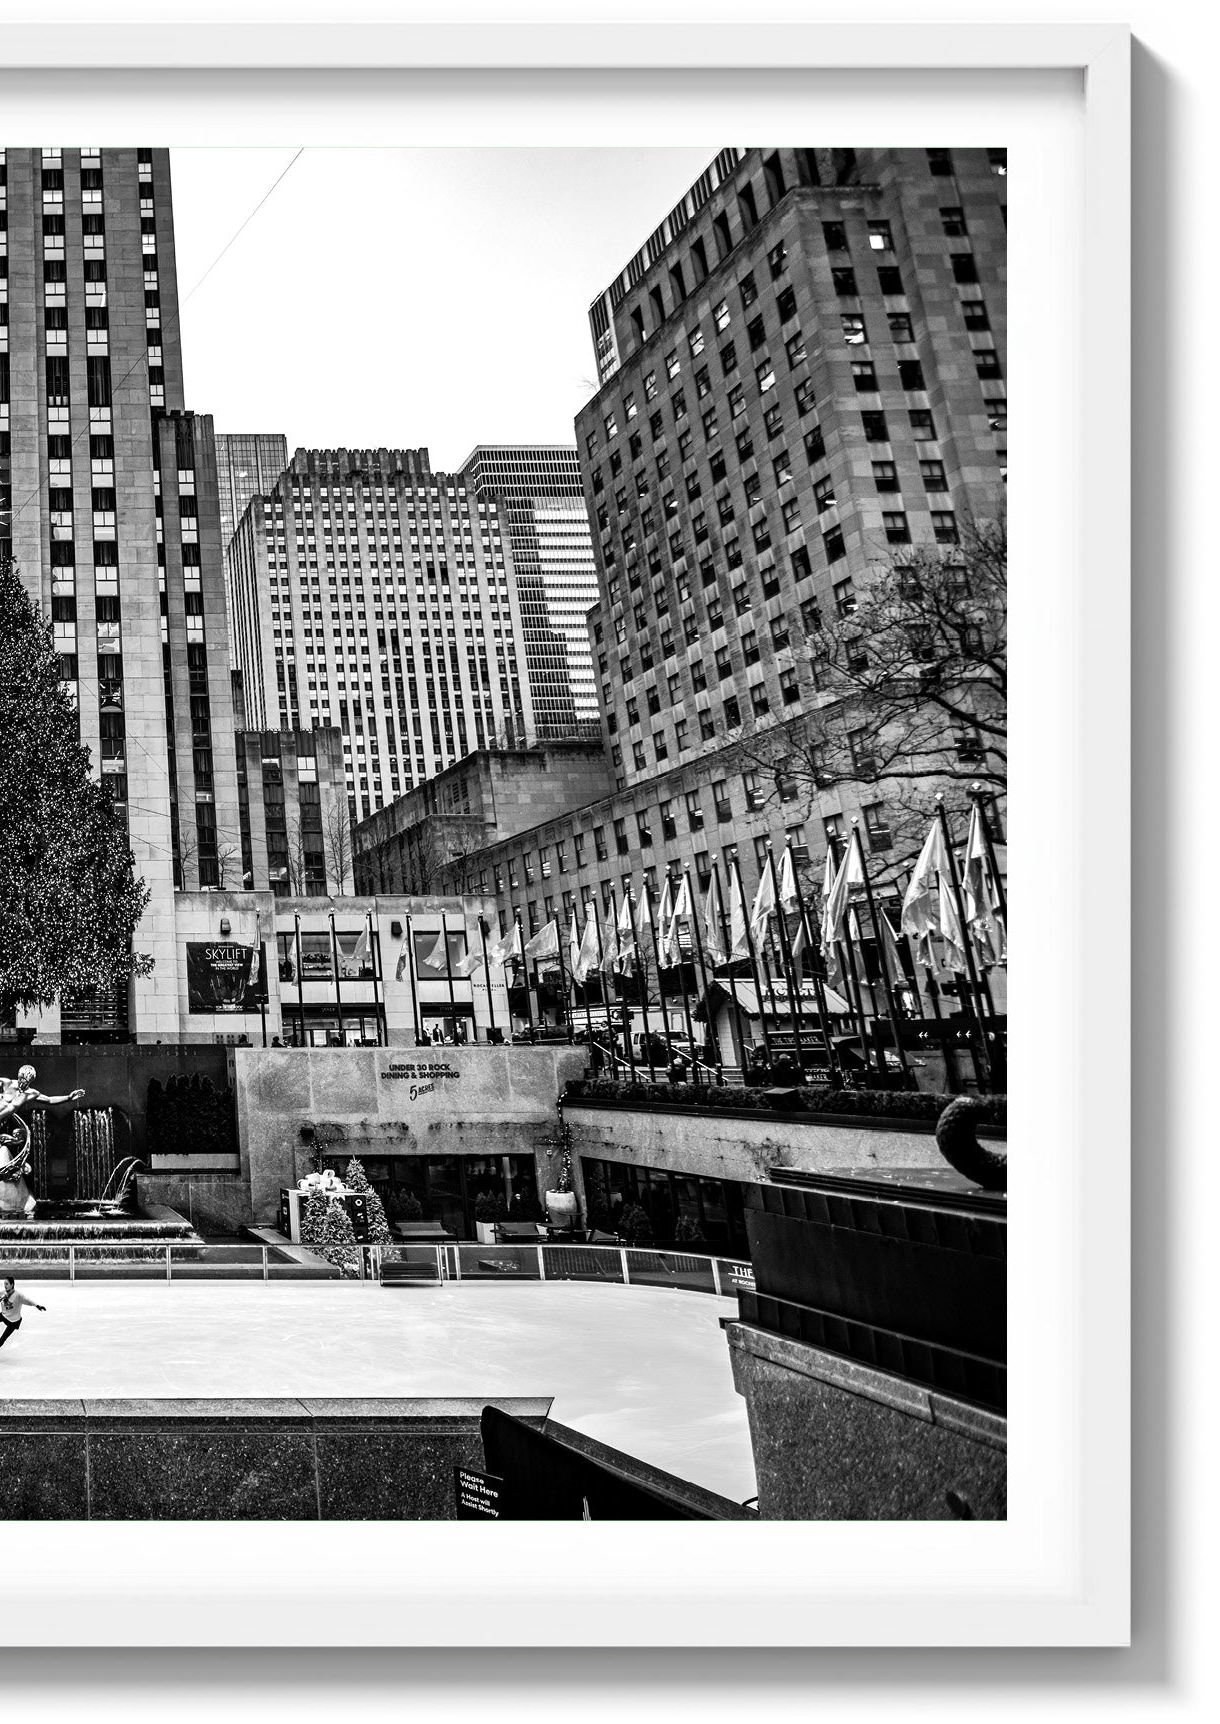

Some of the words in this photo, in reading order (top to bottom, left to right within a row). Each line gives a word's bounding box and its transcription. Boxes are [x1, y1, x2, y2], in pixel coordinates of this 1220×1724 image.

[205, 948, 247, 960] SKYLIFT
[410, 1085, 418, 1101] 5
[732, 1266, 753, 1278] THE
[460, 1471, 484, 1484] Please
[460, 1480, 478, 1491] Wait
[480, 1485, 498, 1498] Here
[466, 1494, 479, 1503] Host
[461, 1499, 477, 1509] Assist
[478, 1505, 499, 1517] Shortly
